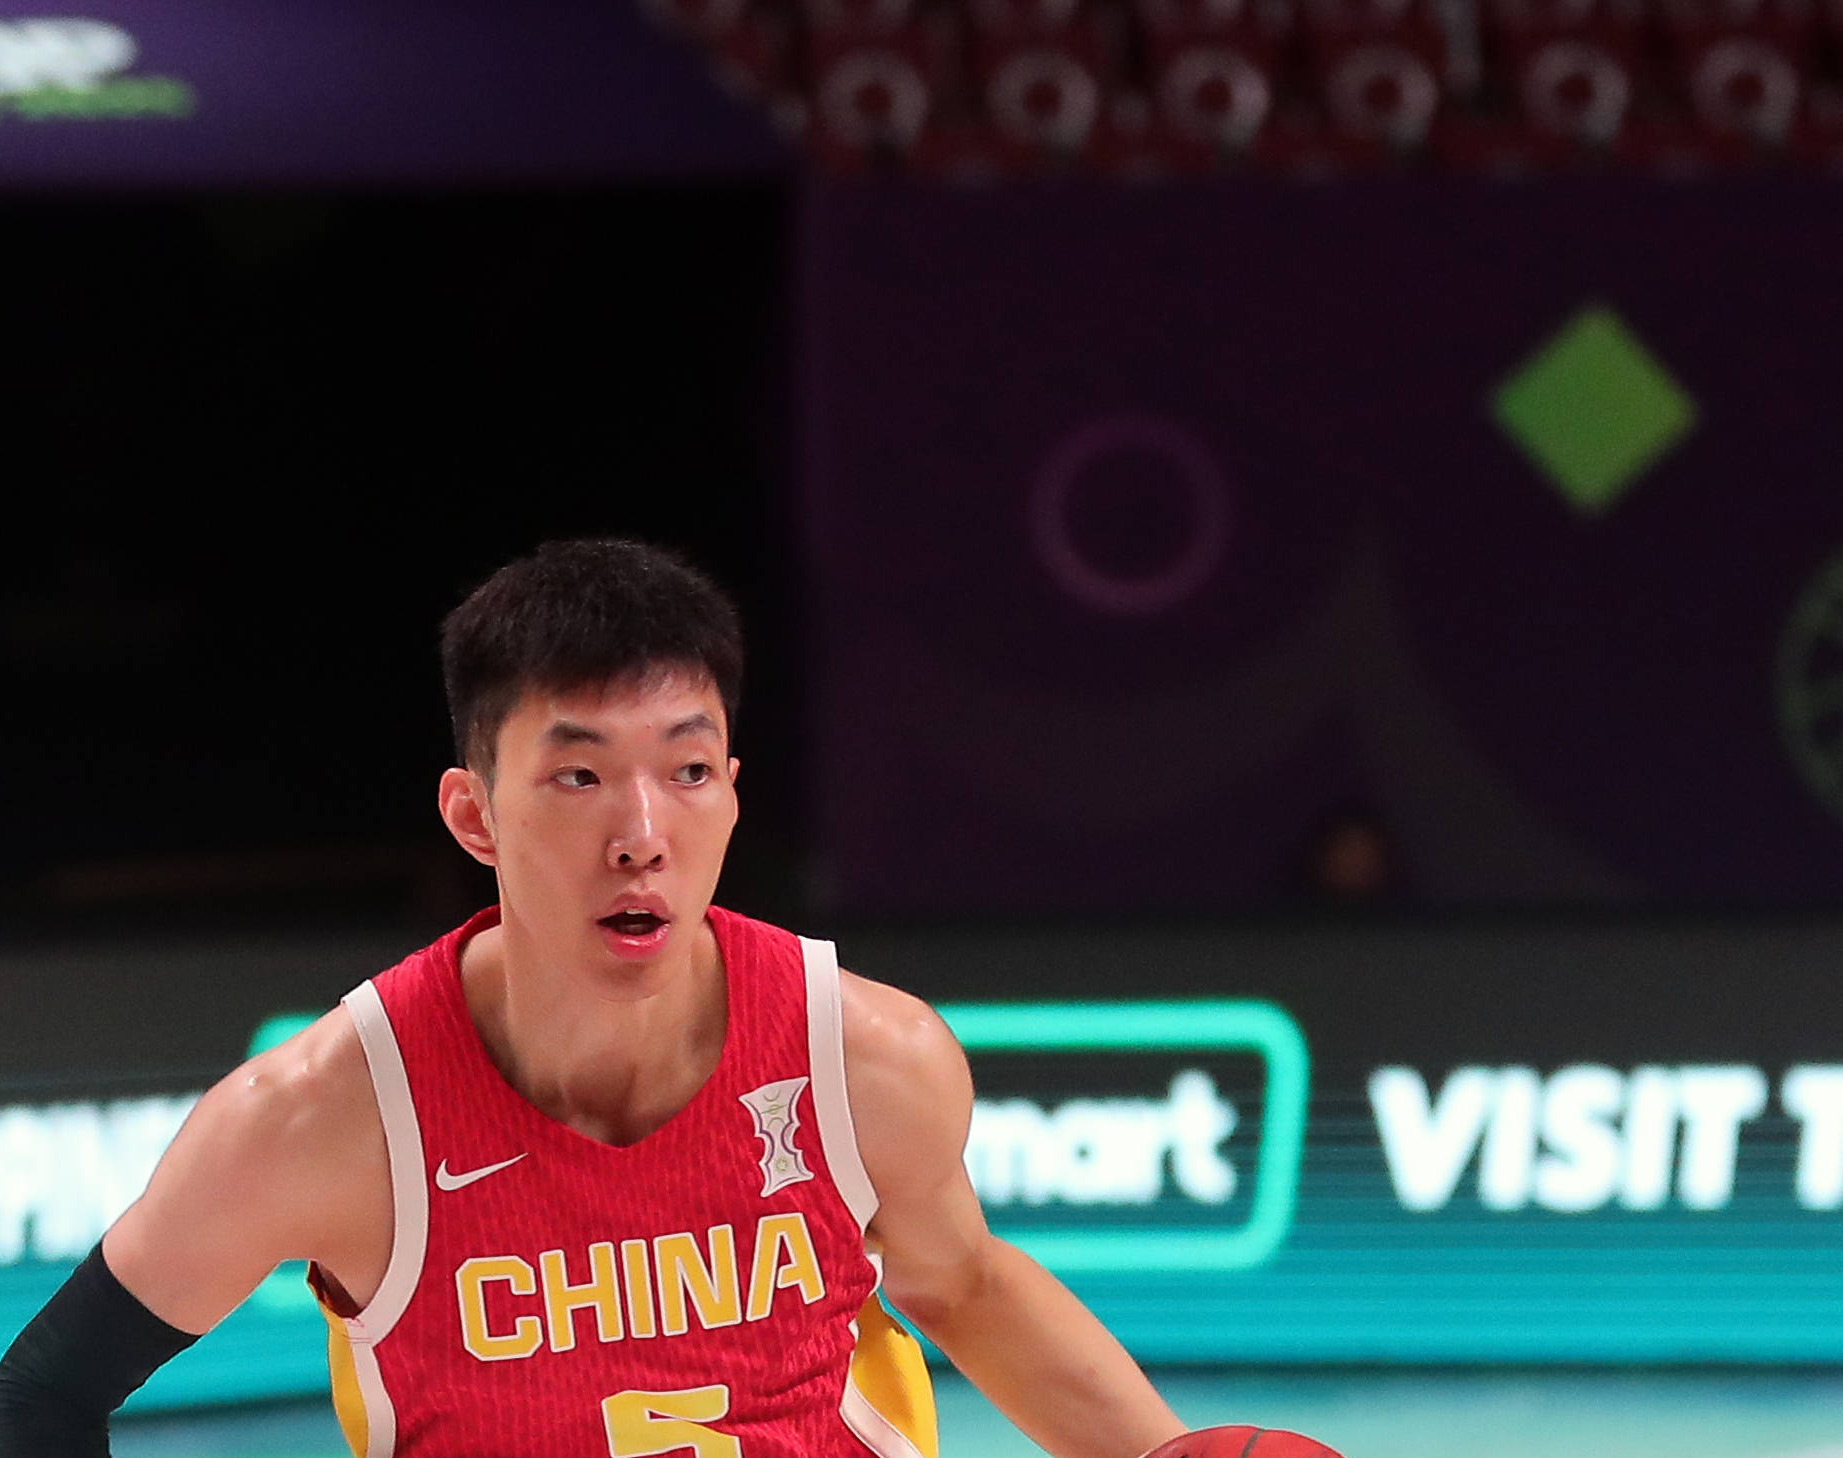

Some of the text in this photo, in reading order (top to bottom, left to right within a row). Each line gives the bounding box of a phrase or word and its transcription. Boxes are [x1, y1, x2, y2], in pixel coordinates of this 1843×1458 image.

[963, 1068, 1237, 1207] mart
[1367, 1064, 1767, 1211] VISIT
[455, 1212, 827, 1362] CHINA
